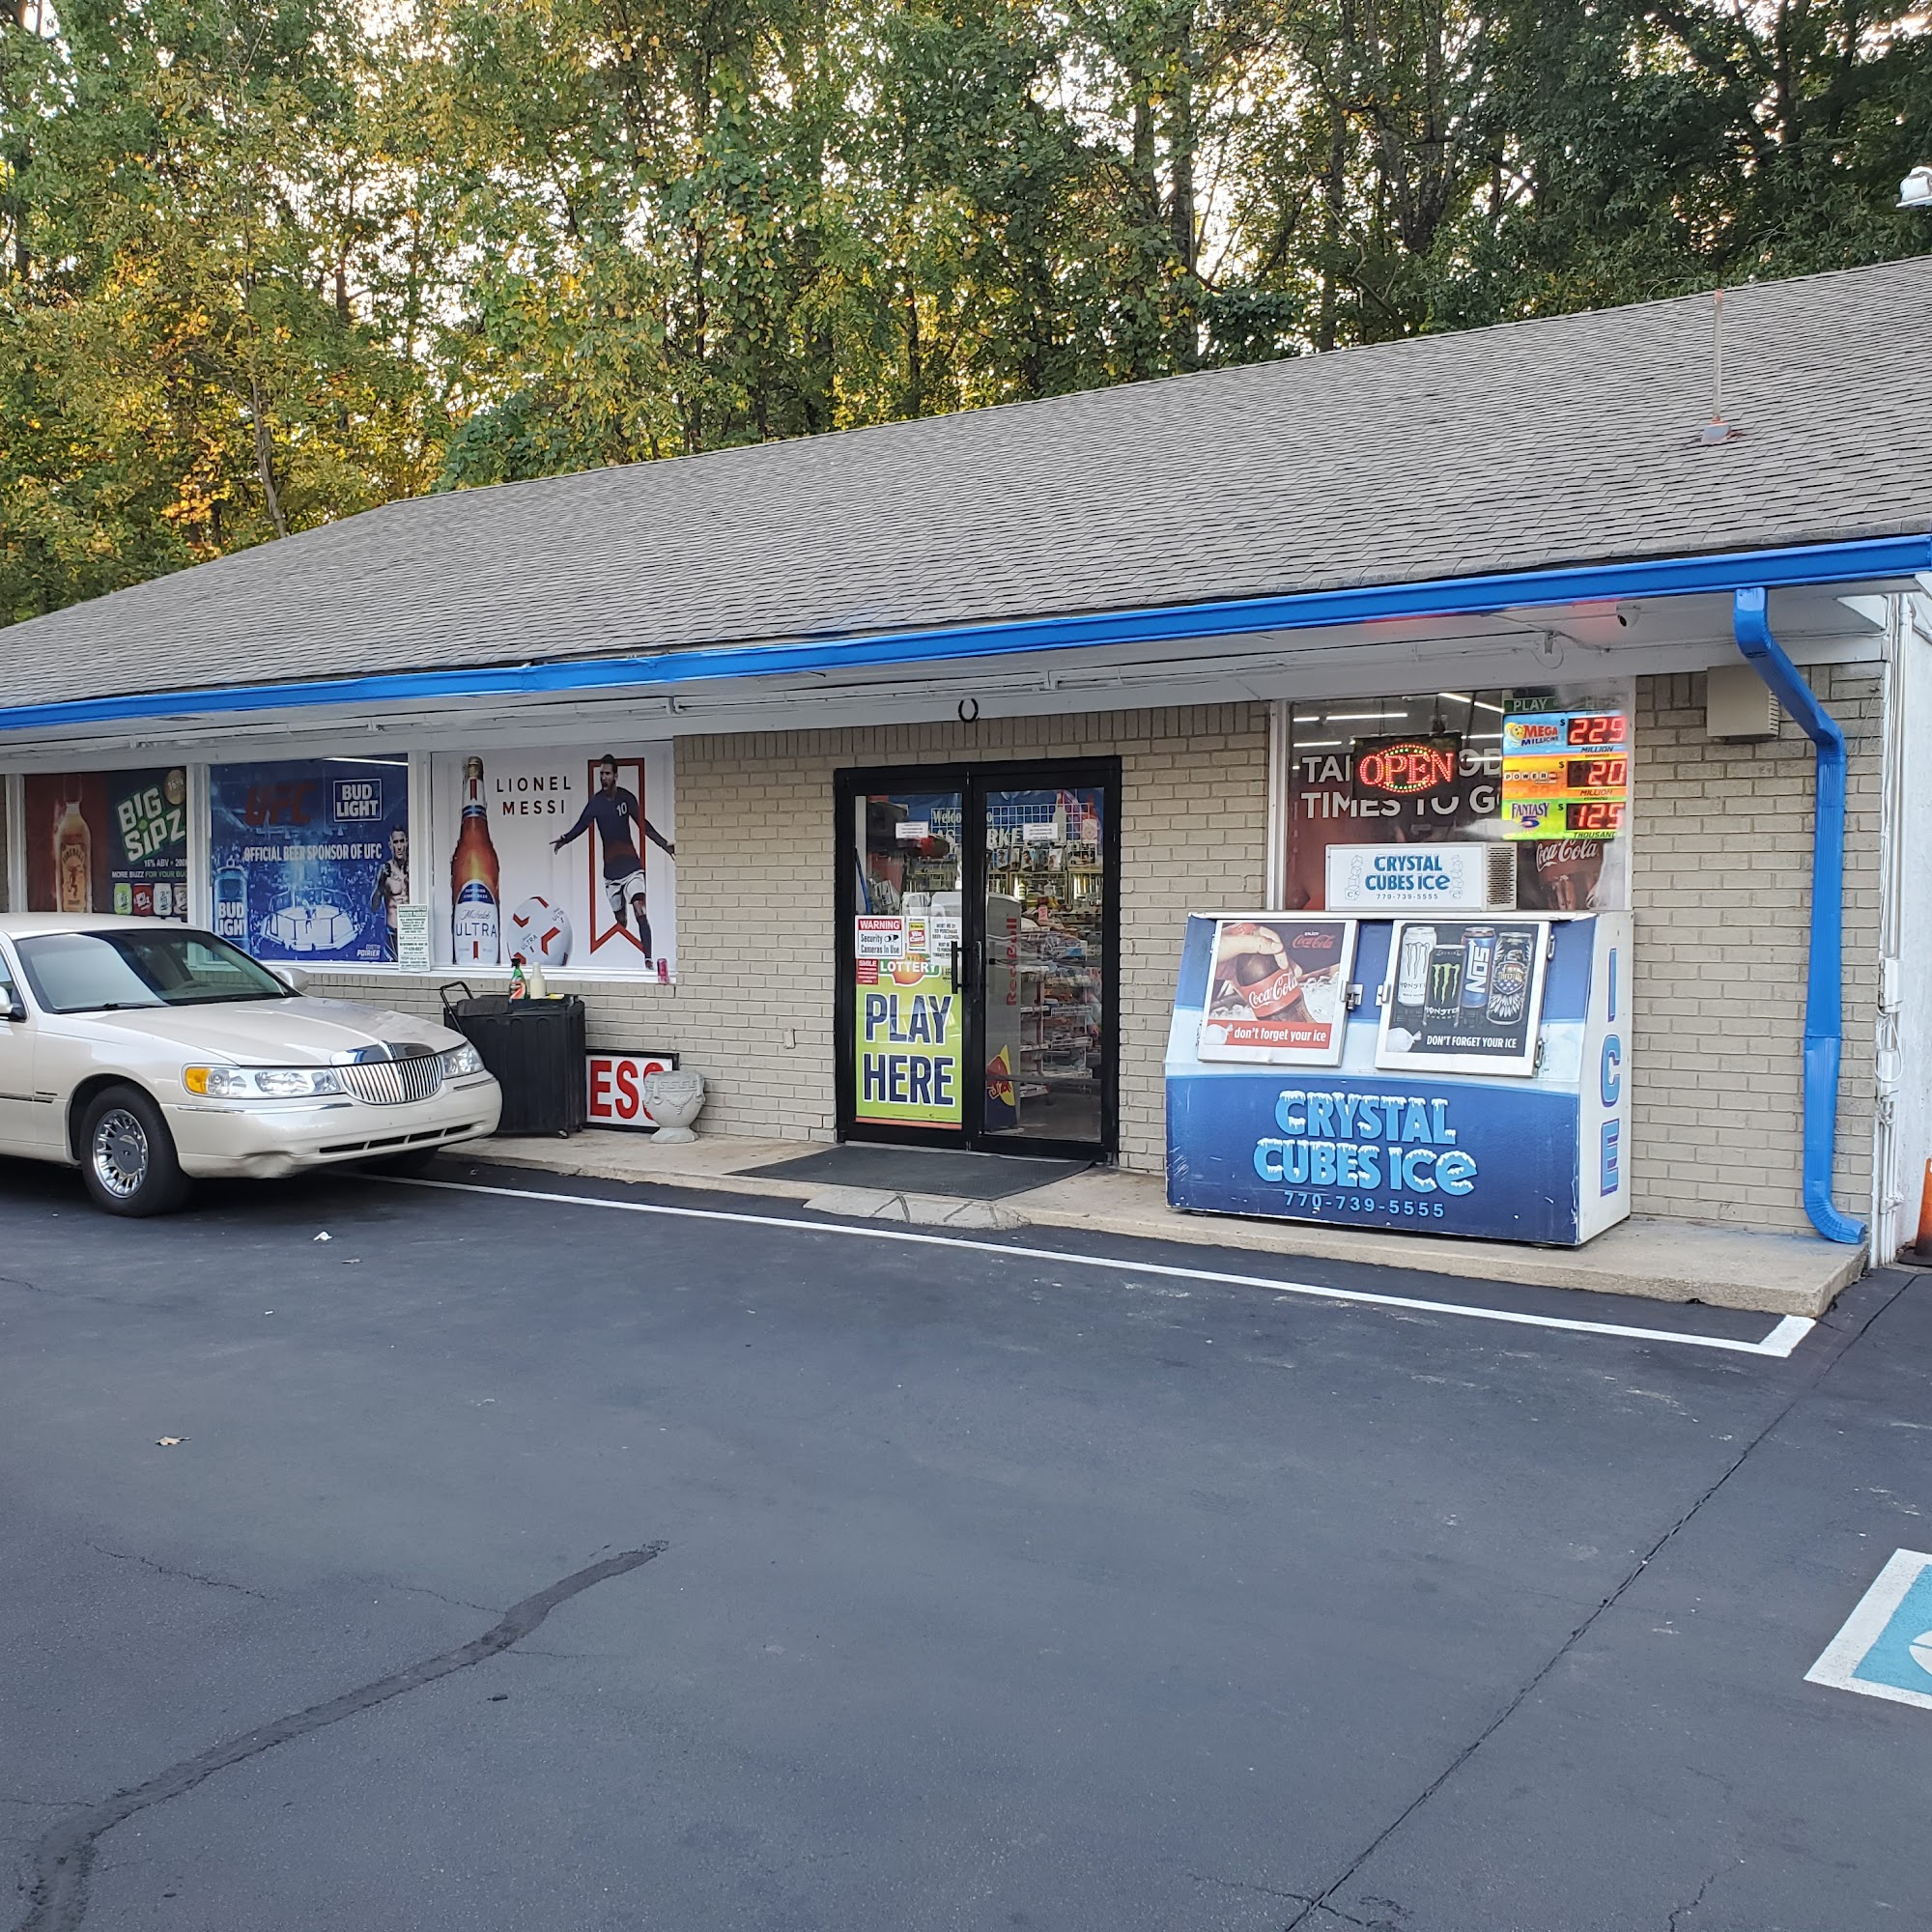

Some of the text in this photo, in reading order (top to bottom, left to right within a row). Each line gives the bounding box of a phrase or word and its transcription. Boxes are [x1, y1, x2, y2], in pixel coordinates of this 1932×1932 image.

[1513, 698, 1548, 711] PLAY
[1524, 724, 1558, 738] MEGA
[1520, 736, 1558, 747] MILLIONS
[1302, 754, 1350, 783] TA
[1359, 753, 1454, 785] OPEN
[1504, 772, 1548, 781] POWER
[1588, 760, 1626, 785] 20
[342, 783, 373, 801] BUD
[497, 776, 572, 793] LIONEL
[117, 787, 162, 833] BIG
[244, 781, 316, 826] UFC
[336, 800, 379, 817] LIGHT
[502, 800, 565, 816] MESSI
[616, 802, 628, 816] 10
[1300, 790, 1401, 819] TIMES
[1511, 802, 1550, 819] FANTASY
[933, 809, 962, 823] Welco
[1520, 816, 1540, 829] 5
[1577, 804, 1625, 829] 125
[243, 842, 383, 863] OFFICIAL BEER SPONSOR OF UFC
[1536, 839, 1598, 872] Coca-Cola
[156, 859, 169, 867] ABV
[1375, 855, 1443, 871] CRYSTAL
[1365, 874, 1414, 891] CUBES
[218, 901, 244, 918] BUD
[455, 923, 497, 938] ULTRA
[860, 920, 901, 930] WARNING
[521, 934, 538, 950] ULTRA
[860, 933, 883, 944] Security
[1293, 934, 1336, 949] Coca-Cola
[356, 949, 381, 957] POIRIER
[861, 945, 883, 954] Cameras
[891, 945, 900, 953] Use
[880, 960, 936, 973] LOTTERY
[1464, 941, 1491, 994] NOS
[1248, 971, 1298, 1009] Coca-Cola
[866, 993, 953, 1045] PLAY
[1234, 1027, 1326, 1043] don't forget your ice
[1426, 1035, 1518, 1049] DON'T FORGET YOUR ICE
[863, 1053, 955, 1107] HERE
[1600, 947, 1621, 1199] ICE
[1274, 1090, 1457, 1146] CRYSTAL
[1253, 1137, 1381, 1191] CUBES
[1284, 1190, 1445, 1219] 770-739-5555
